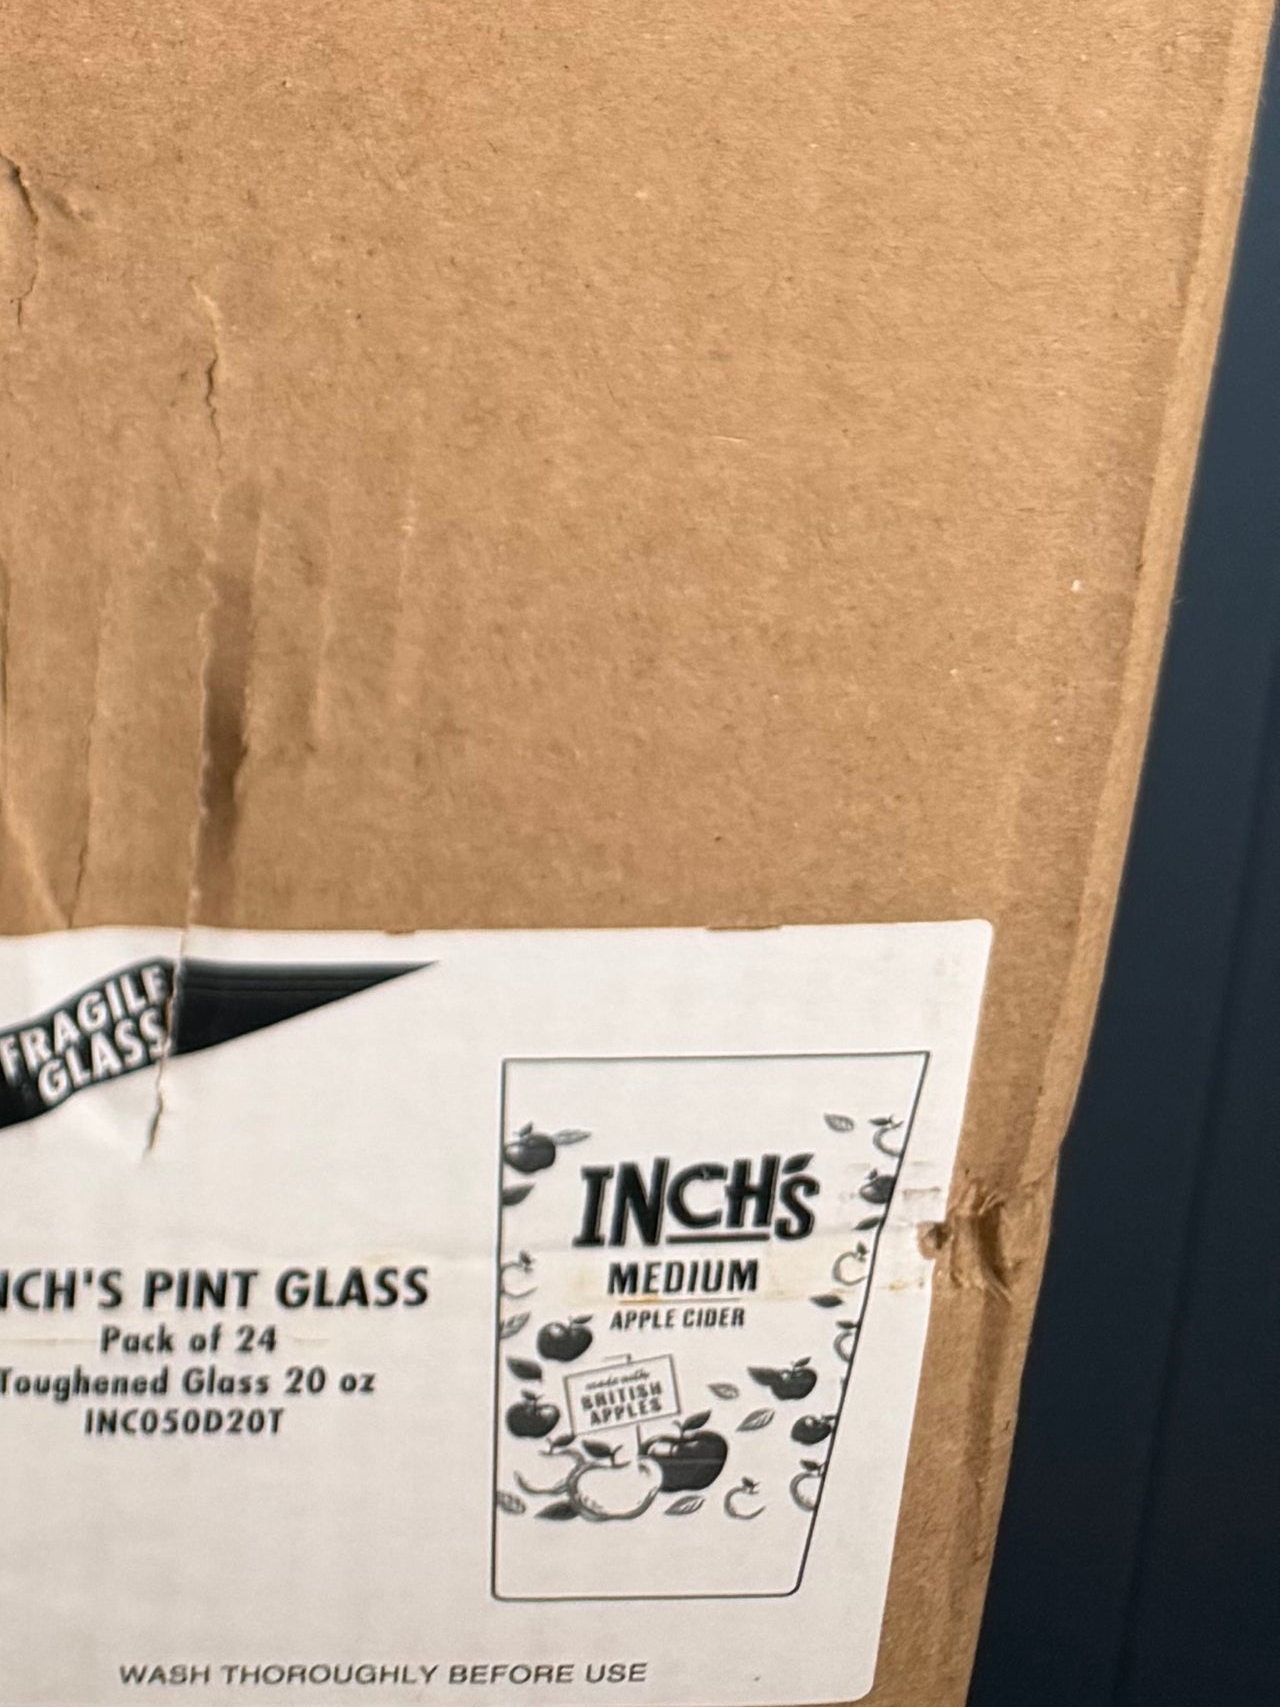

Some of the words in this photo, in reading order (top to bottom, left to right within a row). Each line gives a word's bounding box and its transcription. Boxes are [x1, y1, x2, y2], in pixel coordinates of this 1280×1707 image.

[38, 1007, 166, 1106] GLASS
[142, 1269, 259, 1310] PINT
[275, 1266, 429, 1309] GLASS
[607, 1258, 758, 1295] MEDIUM
[609, 1308, 675, 1331] APPLE
[682, 1307, 745, 1329] CIDER
[100, 1324, 174, 1354] Pack
[189, 1324, 221, 1352] of
[239, 1324, 277, 1352] 24
[182, 1366, 269, 1395] Glass
[284, 1366, 326, 1394] 20
[339, 1371, 376, 1394] oz
[590, 1397, 662, 1425] APPLES
[119, 1664, 210, 1685] WASH
[221, 1663, 439, 1685] THOROUGHLY
[448, 1663, 574, 1684] BEFORE
[586, 1662, 648, 1683] USE
